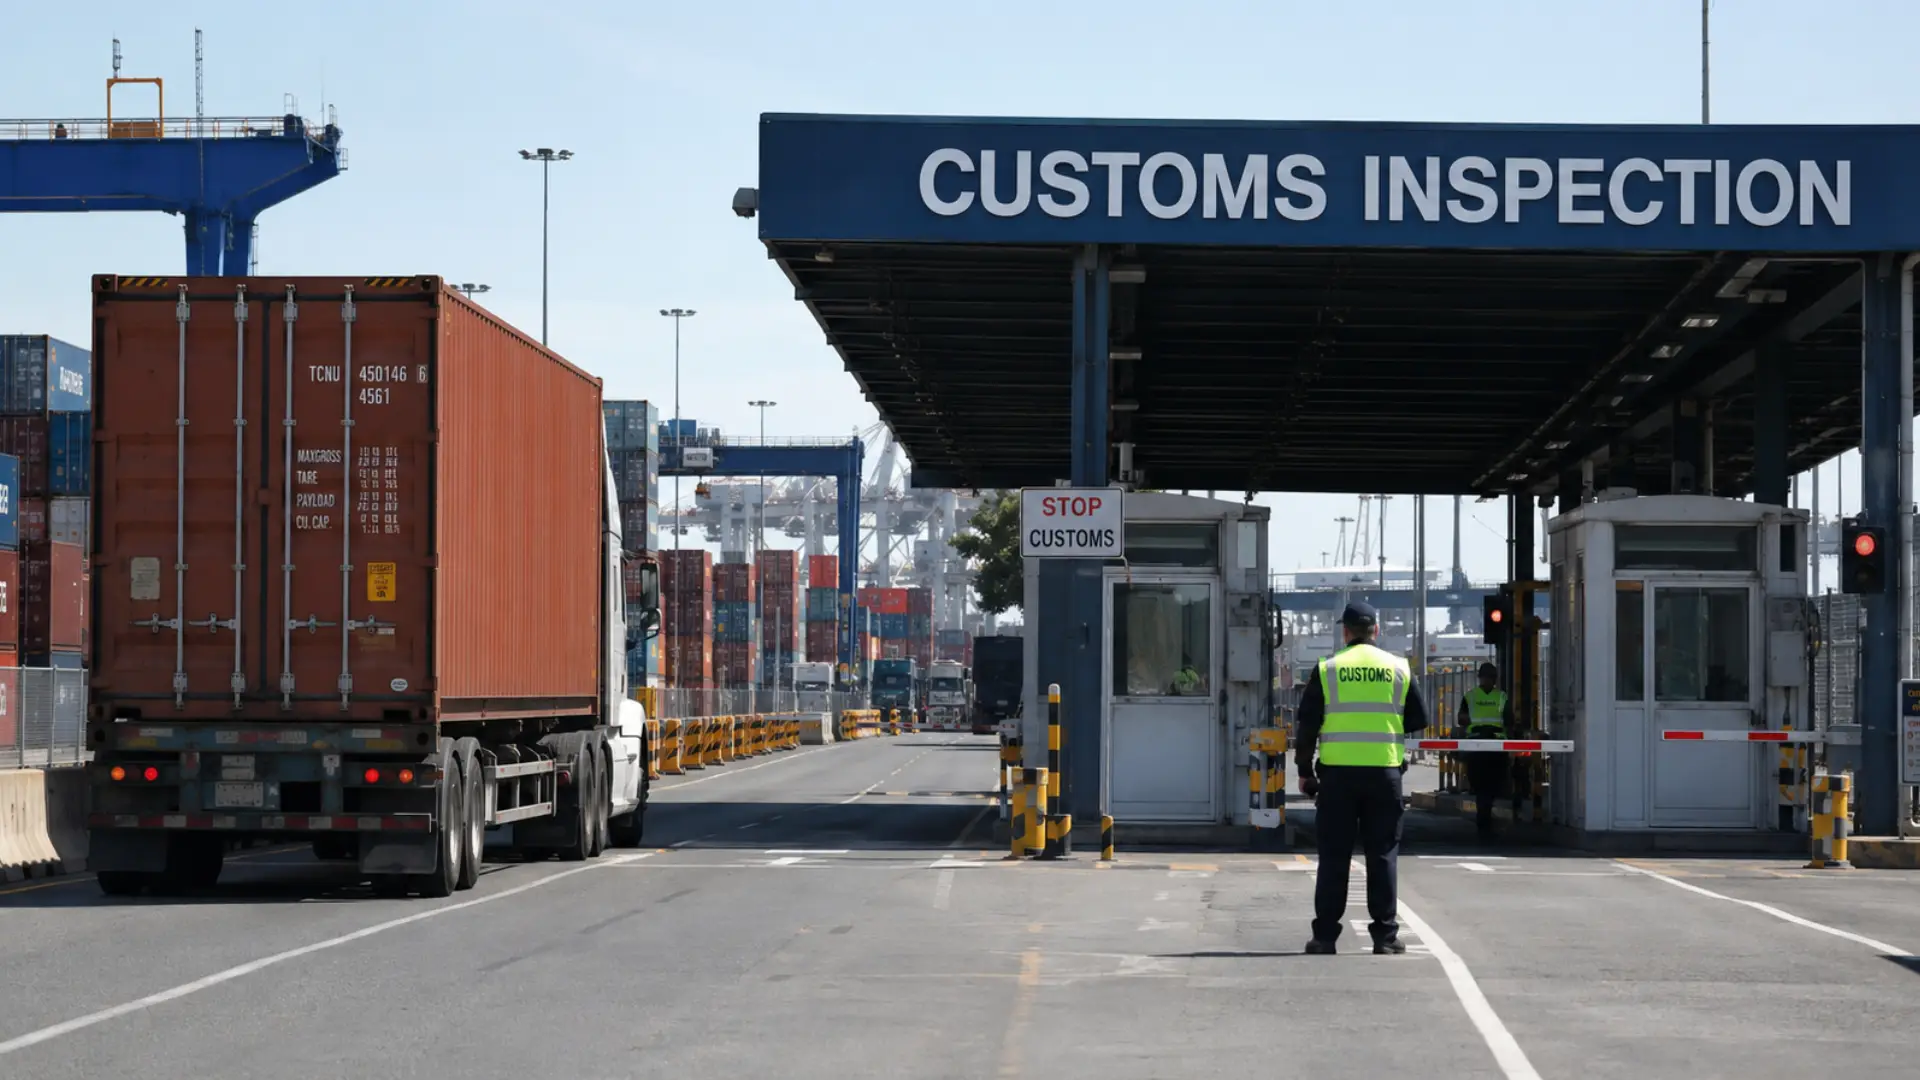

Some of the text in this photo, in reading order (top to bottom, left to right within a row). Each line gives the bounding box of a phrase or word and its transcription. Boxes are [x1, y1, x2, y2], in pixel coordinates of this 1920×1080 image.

[919, 148, 1851, 226] CUSTOMS INSPECTION
[309, 365, 340, 382] TCNU
[359, 365, 407, 382] 450146
[359, 387, 390, 404] 4561
[296, 470, 318, 485] TARE
[296, 493, 335, 508] PAYLOAD
[1042, 496, 1102, 516] STOP
[1029, 529, 1115, 548] CUSTOMS
[1339, 667, 1393, 682] CUSTOMS
